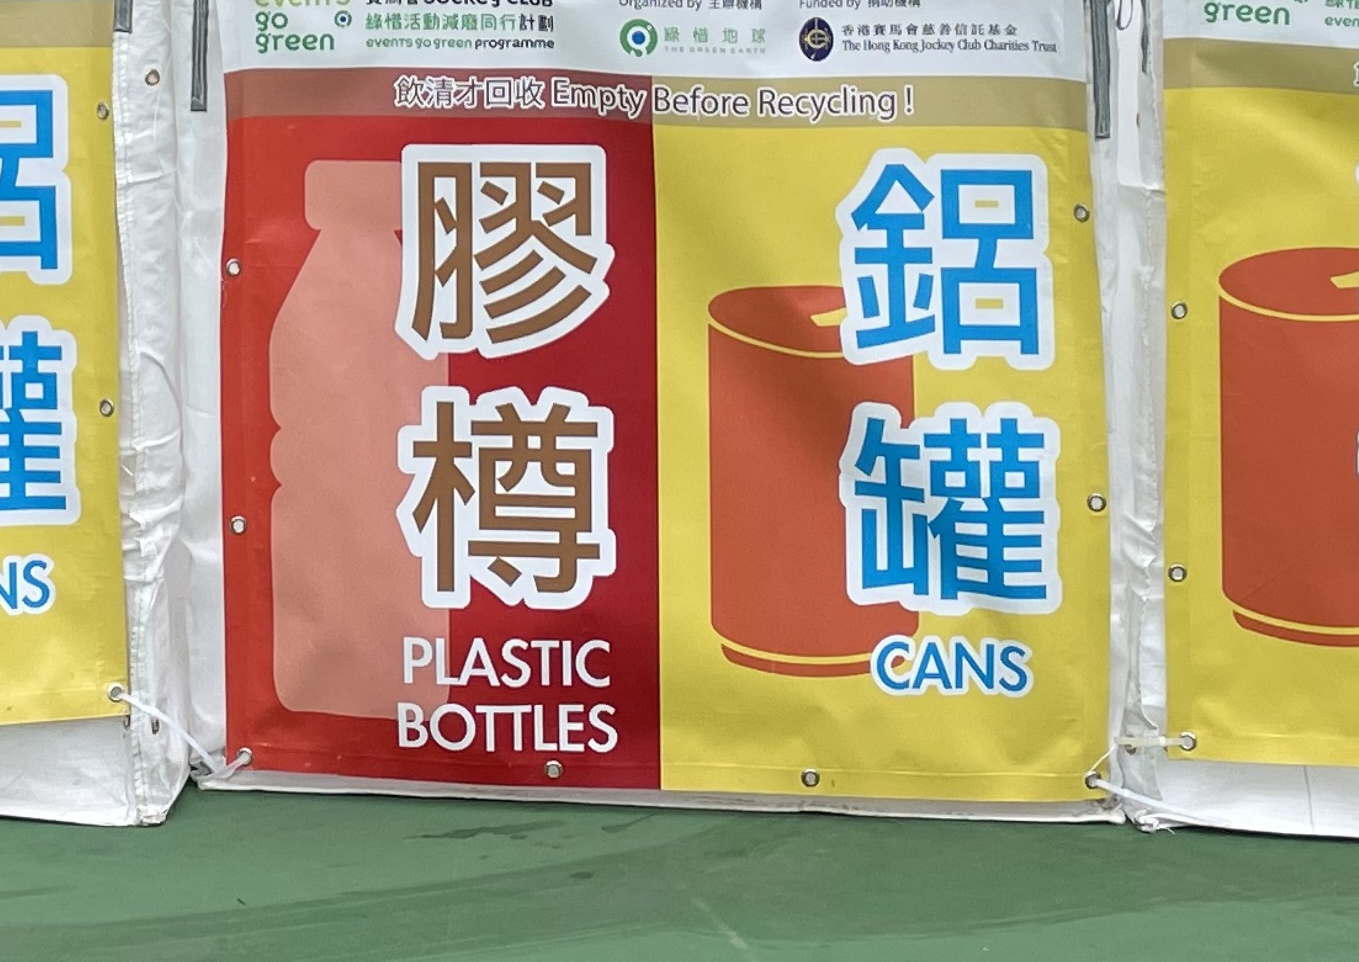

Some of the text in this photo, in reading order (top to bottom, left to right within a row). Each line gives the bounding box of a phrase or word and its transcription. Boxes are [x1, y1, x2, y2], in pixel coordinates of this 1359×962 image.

[254, 10, 289, 32] go
[1203, 1, 1290, 26] green
[254, 32, 336, 54] green
[434, 38, 472, 49] green
[474, 38, 555, 50] programme
[842, 39, 861, 51] The
[863, 39, 891, 52] Hong
[893, 39, 918, 52] Kong
[921, 39, 955, 52] Jockey
[958, 39, 982, 51] Club
[1031, 40, 1058, 53] Trust
[393, 75, 546, 109] 飲清才回收
[552, 78, 646, 117] Empty
[652, 85, 749, 116] Before
[757, 87, 897, 123] Recycling
[406, 156, 605, 599] 膠樽
[845, 158, 1052, 606] 鋁罐
[402, 636, 611, 687] PLASTIC
[876, 639, 1029, 693] CANS
[396, 701, 618, 752] BOTTLES
